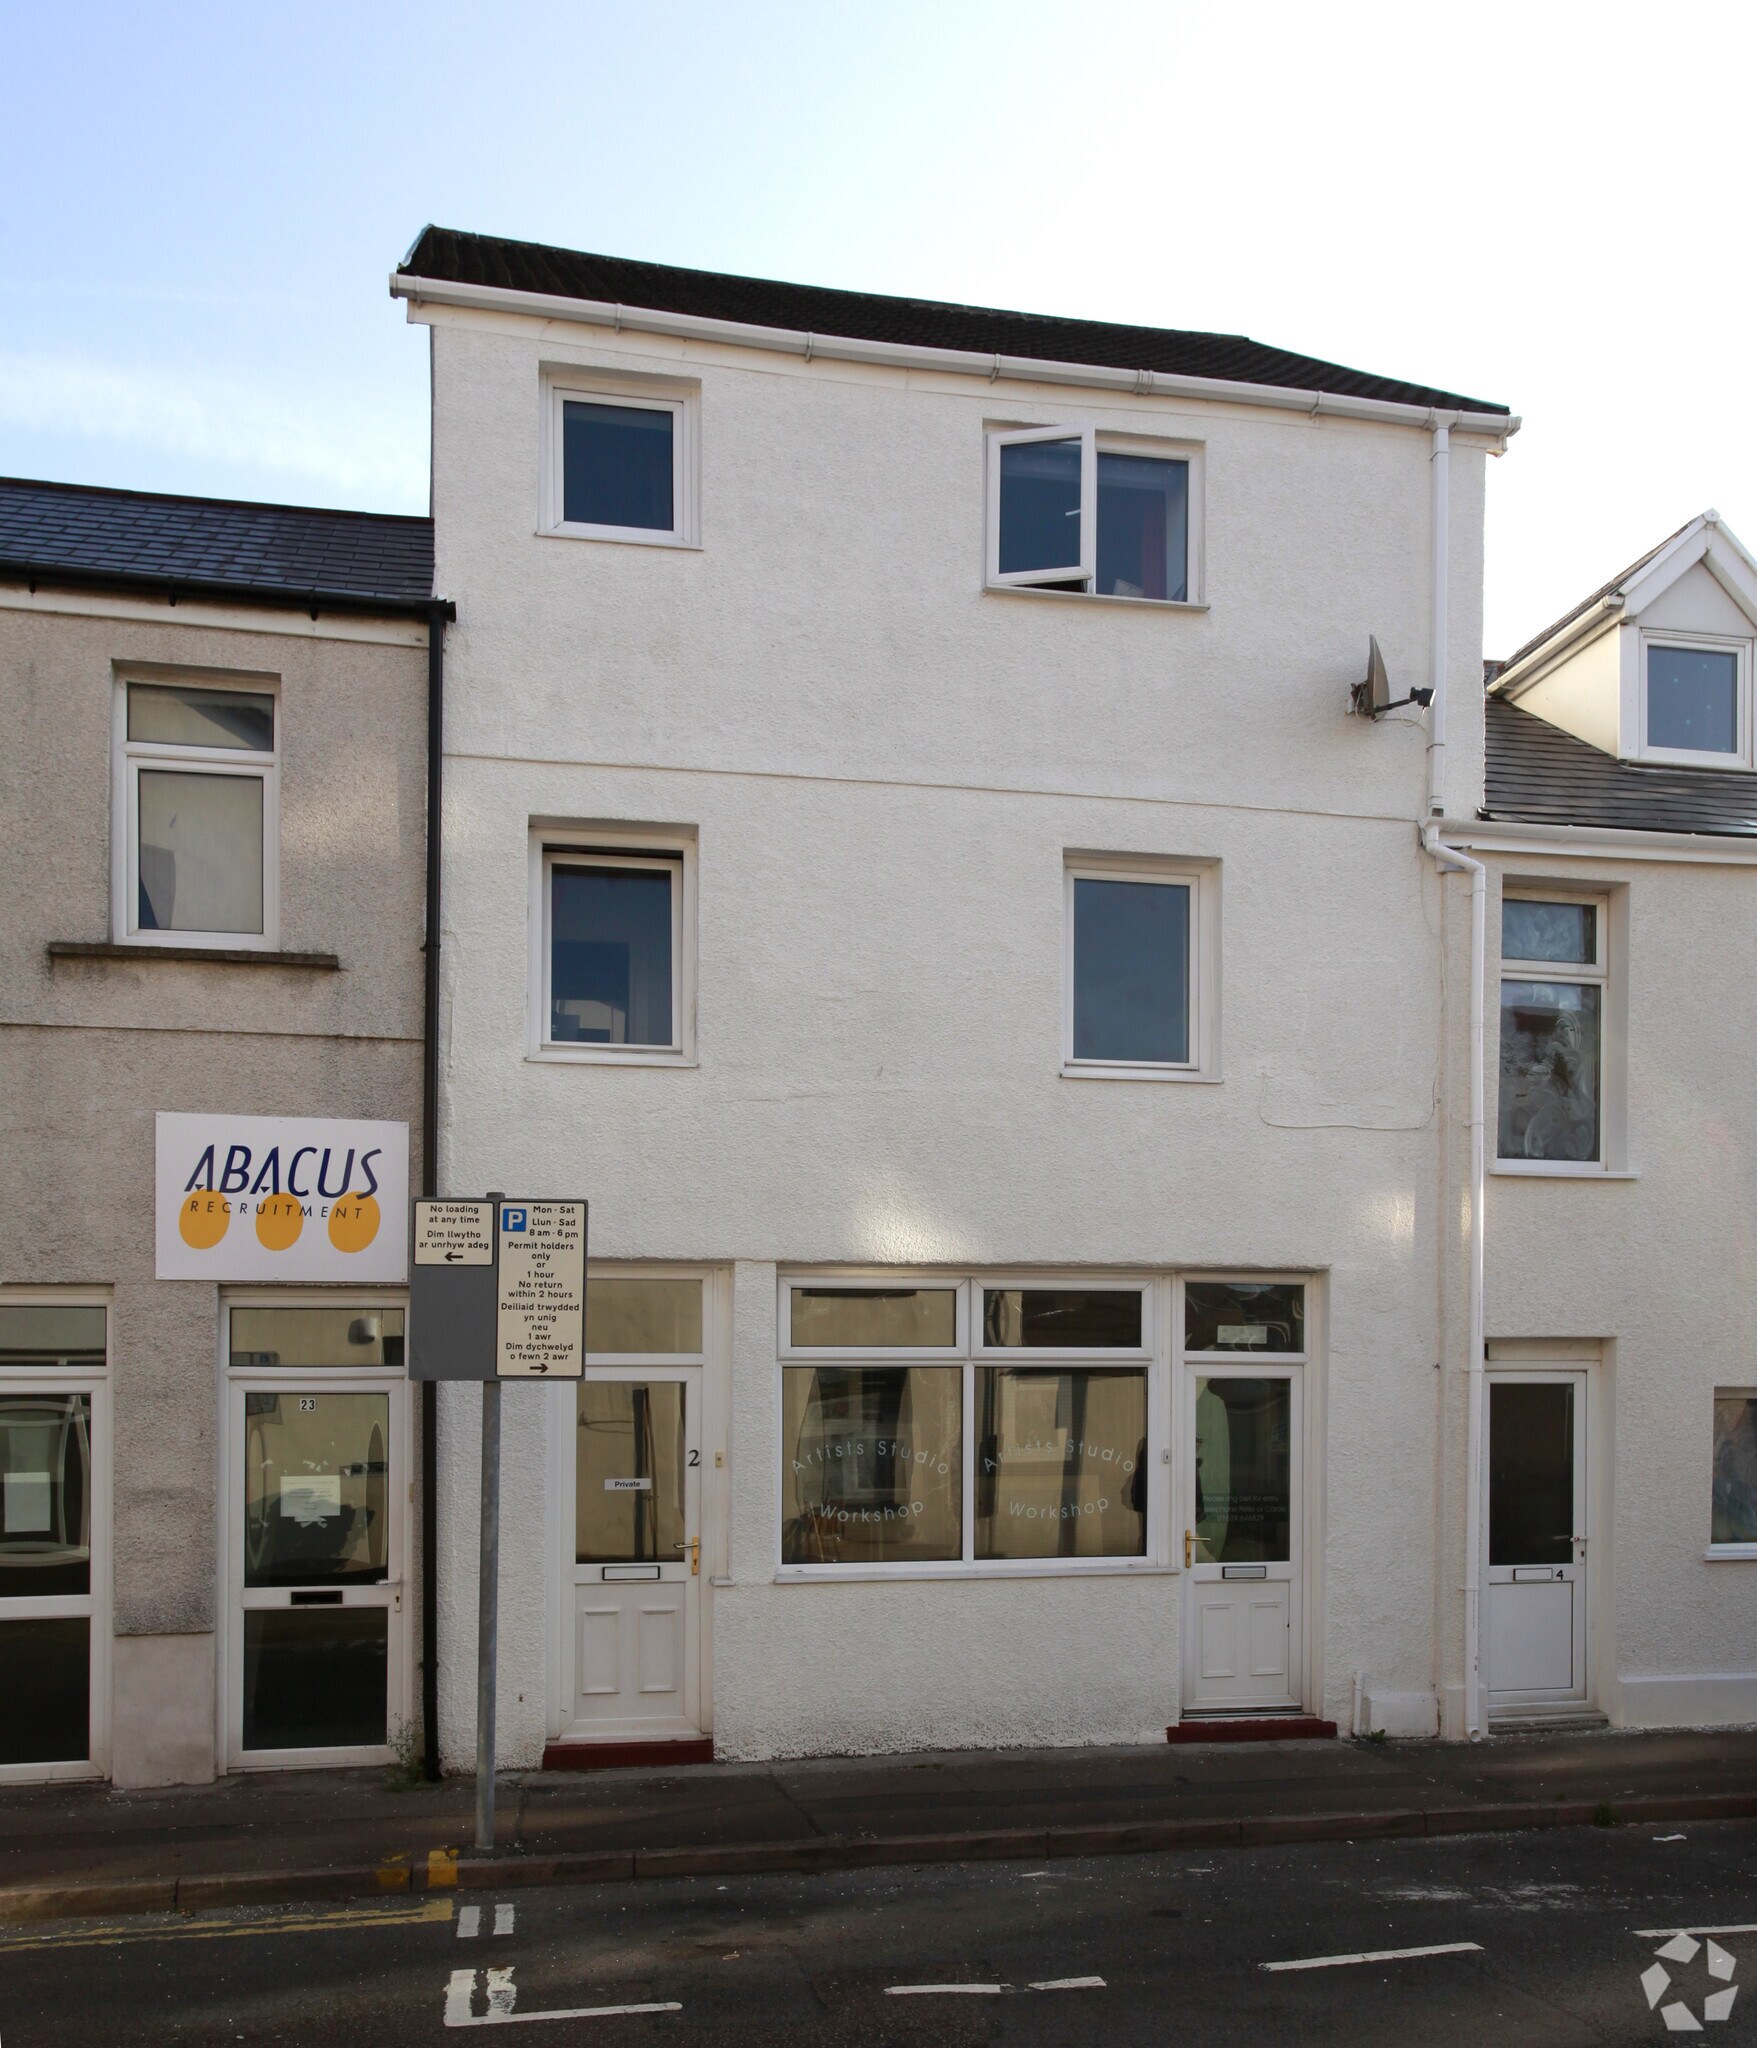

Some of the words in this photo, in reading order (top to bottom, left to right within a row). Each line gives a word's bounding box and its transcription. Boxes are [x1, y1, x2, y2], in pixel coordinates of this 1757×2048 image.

[184, 1144, 382, 1200] ABACUS
[190, 1201, 362, 1219] RECRUITMENT
[446, 1205, 479, 1214] loading
[448, 1231, 481, 1239] llwytho
[432, 1241, 464, 1249] unrhyw
[468, 1242, 488, 1250] adeg
[532, 1253, 550, 1261] only
[538, 1304, 579, 1312] trwydded
[538, 1314, 556, 1322] unig
[301, 1400, 315, 1410] 23
[687, 1449, 700, 1467] 2
[792, 1440, 864, 1474] Artists
[878, 1440, 949, 1475] Studio
[983, 1440, 1054, 1472] Artists
[1066, 1439, 1134, 1472] Studio
[614, 1480, 641, 1488] Private
[819, 1501, 923, 1523] Workshop
[1009, 1498, 1109, 1520] Workshop
[1556, 1569, 1564, 1580] 4
